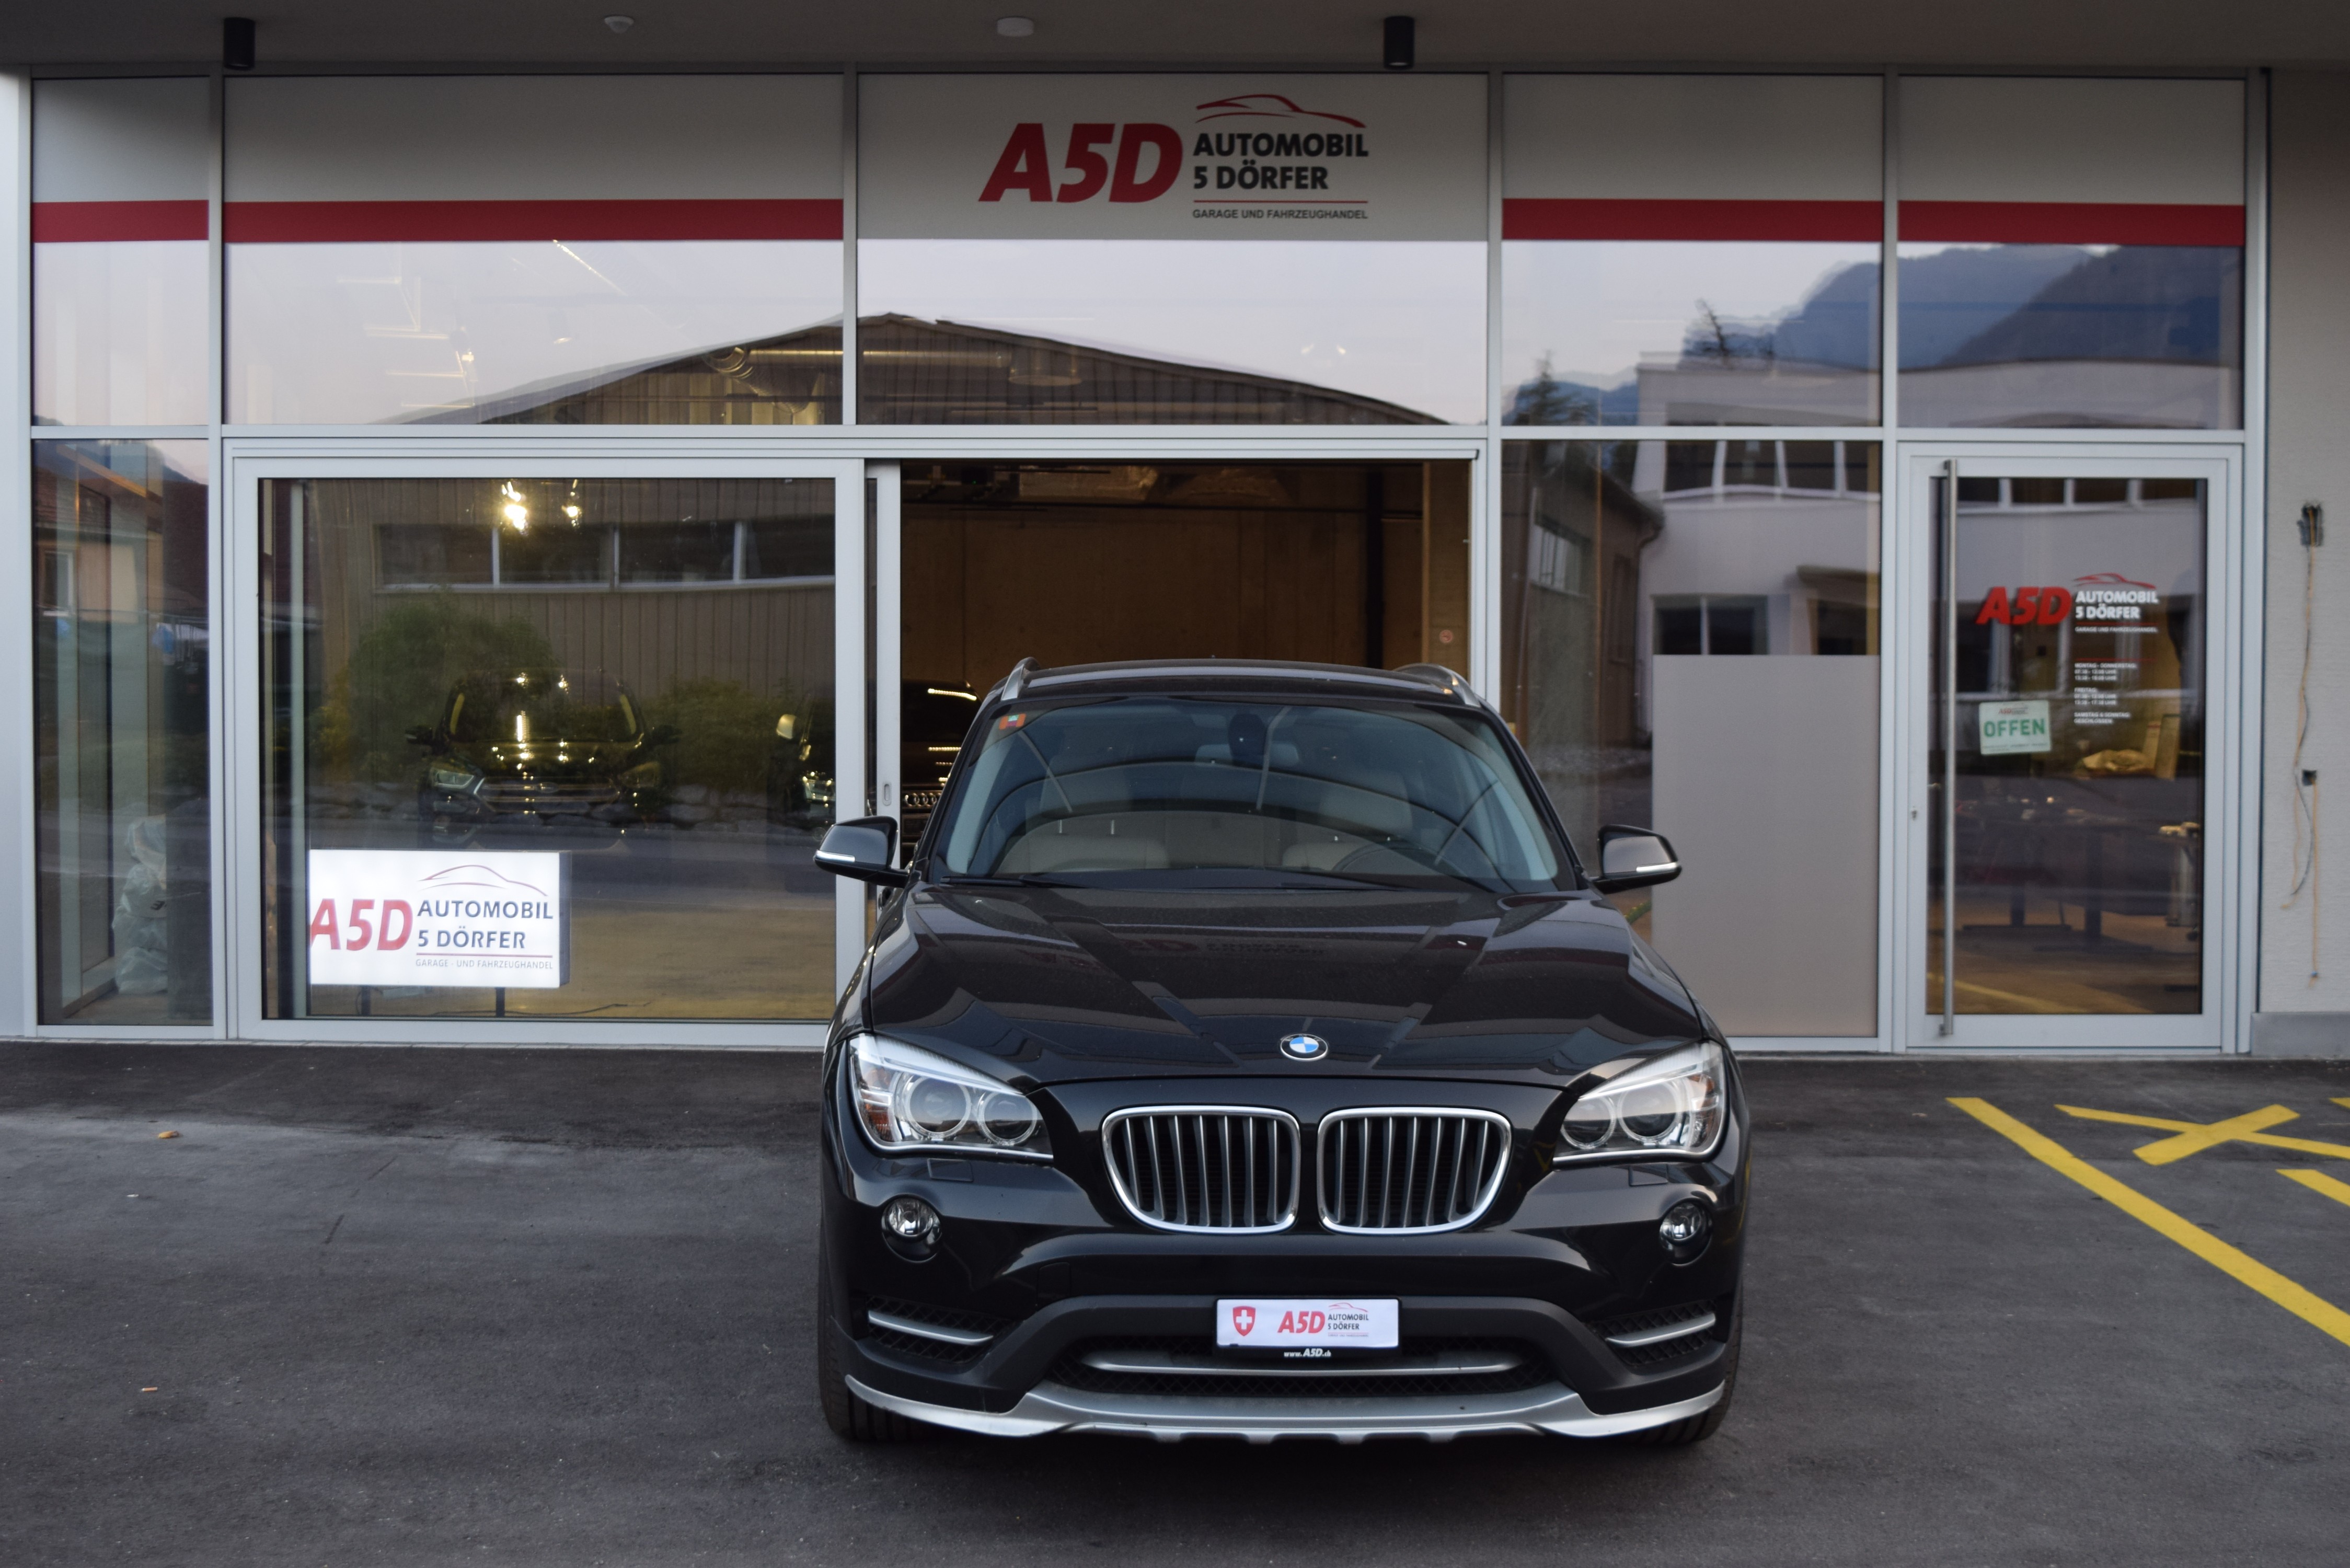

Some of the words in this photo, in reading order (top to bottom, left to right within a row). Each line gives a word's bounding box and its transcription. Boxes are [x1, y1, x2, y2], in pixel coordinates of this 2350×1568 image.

[1193, 133, 1368, 157] AUTOMOBIL
[978, 123, 1183, 203] A5D
[1193, 166, 1208, 189] 5
[1217, 159, 1329, 189] DÖRFER
[1193, 210, 1239, 219] GARAGE
[1241, 210, 1264, 218] UND
[1267, 210, 1368, 219] FAHRZEUGHANDEL
[1975, 586, 2072, 625] A5D
[2075, 591, 2159, 603] AUTOMOBIL
[2075, 606, 2084, 619] 5
[2086, 603, 2140, 619] DÖRFER
[1984, 718, 2045, 737] OFFEN
[417, 900, 554, 919] AUTOMOBIL
[310, 898, 414, 951] A5D
[418, 929, 429, 947] 5
[437, 926, 526, 949] DÖRFER
[416, 959, 449, 969] GARAGE
[456, 960, 475, 968] UND
[477, 960, 553, 970] FAHRZEUGHANDEL
[1277, 1310, 1326, 1334] A5D
[1333, 1321, 1360, 1330] DÖRFER
[1284, 1348, 1332, 1357] www.A5D.ch
